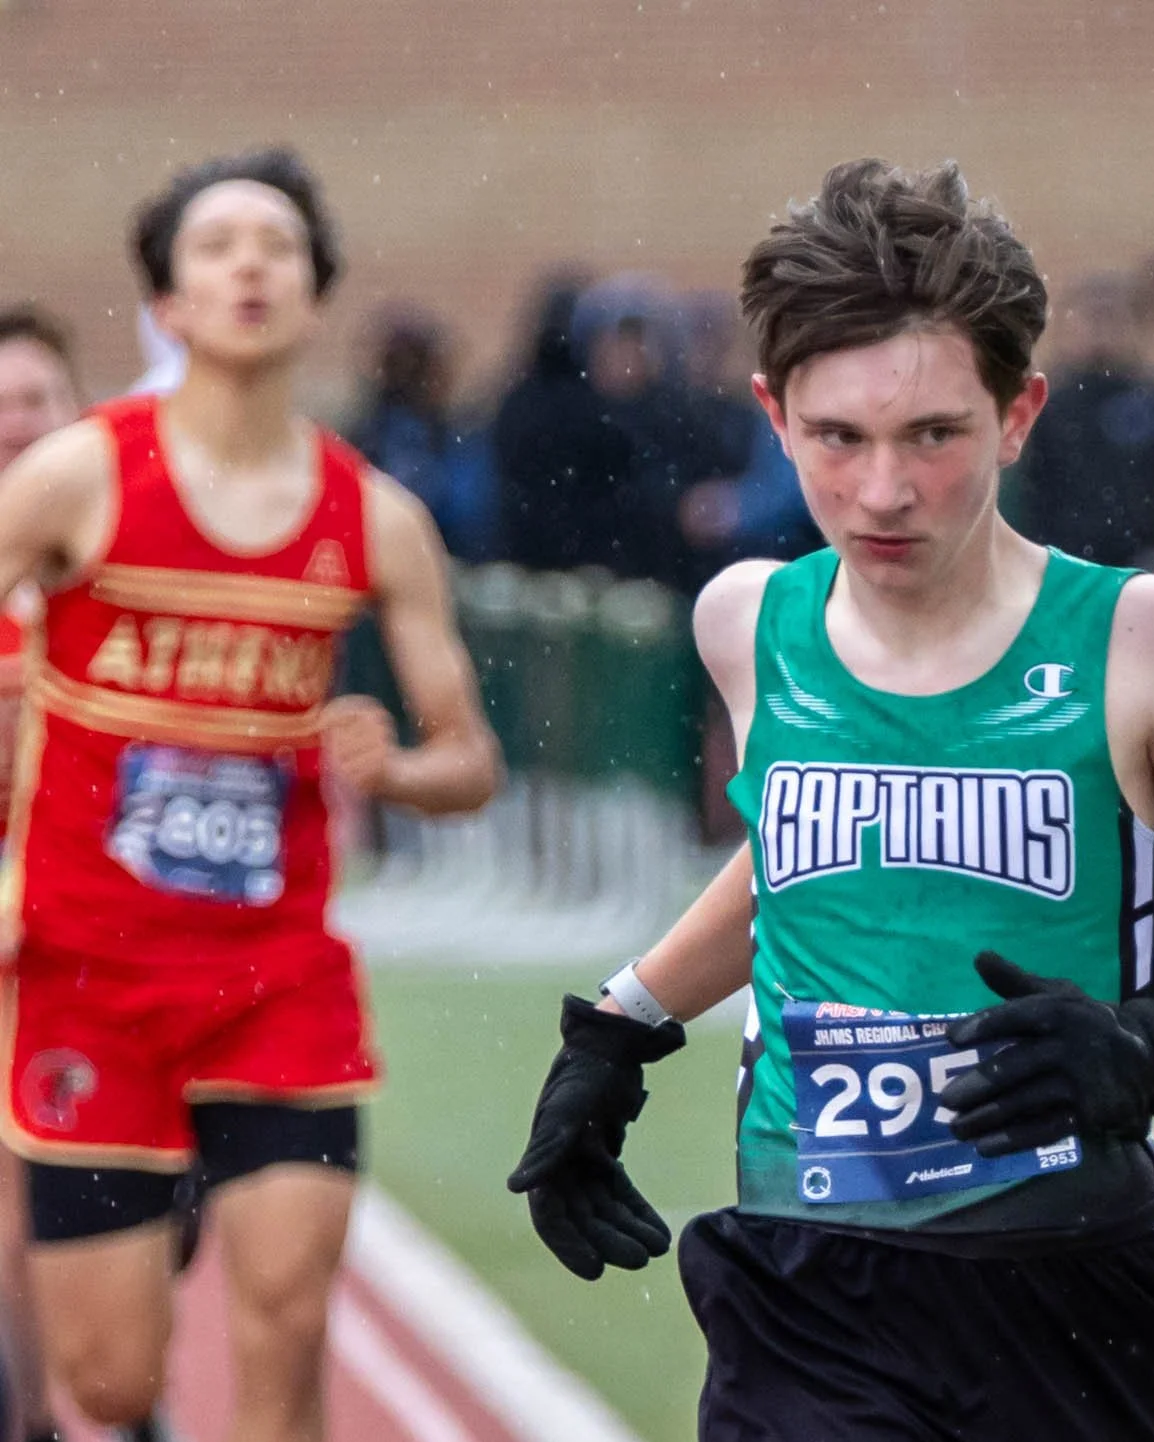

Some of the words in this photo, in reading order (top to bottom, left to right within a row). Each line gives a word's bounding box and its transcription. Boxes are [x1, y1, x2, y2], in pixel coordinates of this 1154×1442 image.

[759, 762, 1073, 899] CAPTAINS
[814, 1028, 854, 1046] JH/MS
[855, 1024, 920, 1045] REGIONAL
[1039, 1151, 1078, 1169] 2953
